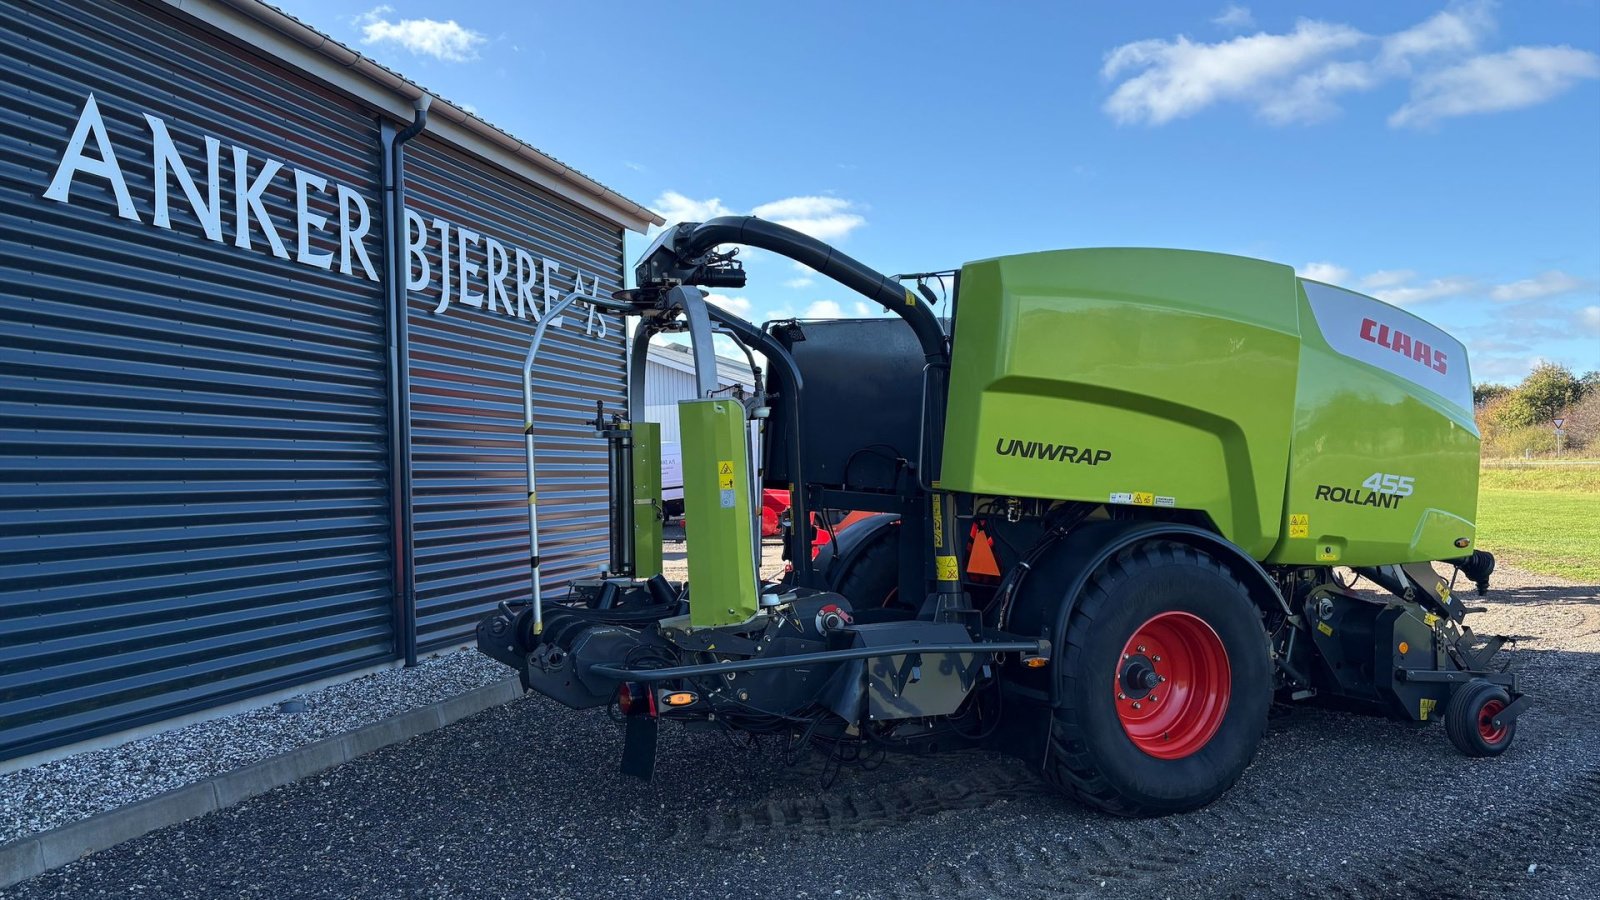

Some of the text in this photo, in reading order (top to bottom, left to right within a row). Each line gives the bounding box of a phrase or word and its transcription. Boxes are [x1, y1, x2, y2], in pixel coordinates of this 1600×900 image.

[43, 92, 380, 282] ANKER
[404, 208, 563, 328] BJERRE
[1360, 317, 1448, 375] CLAAS
[996, 437, 1112, 466] UNIWRAP
[1315, 484, 1403, 510] ROLLANT
[1362, 472, 1415, 497] 455
